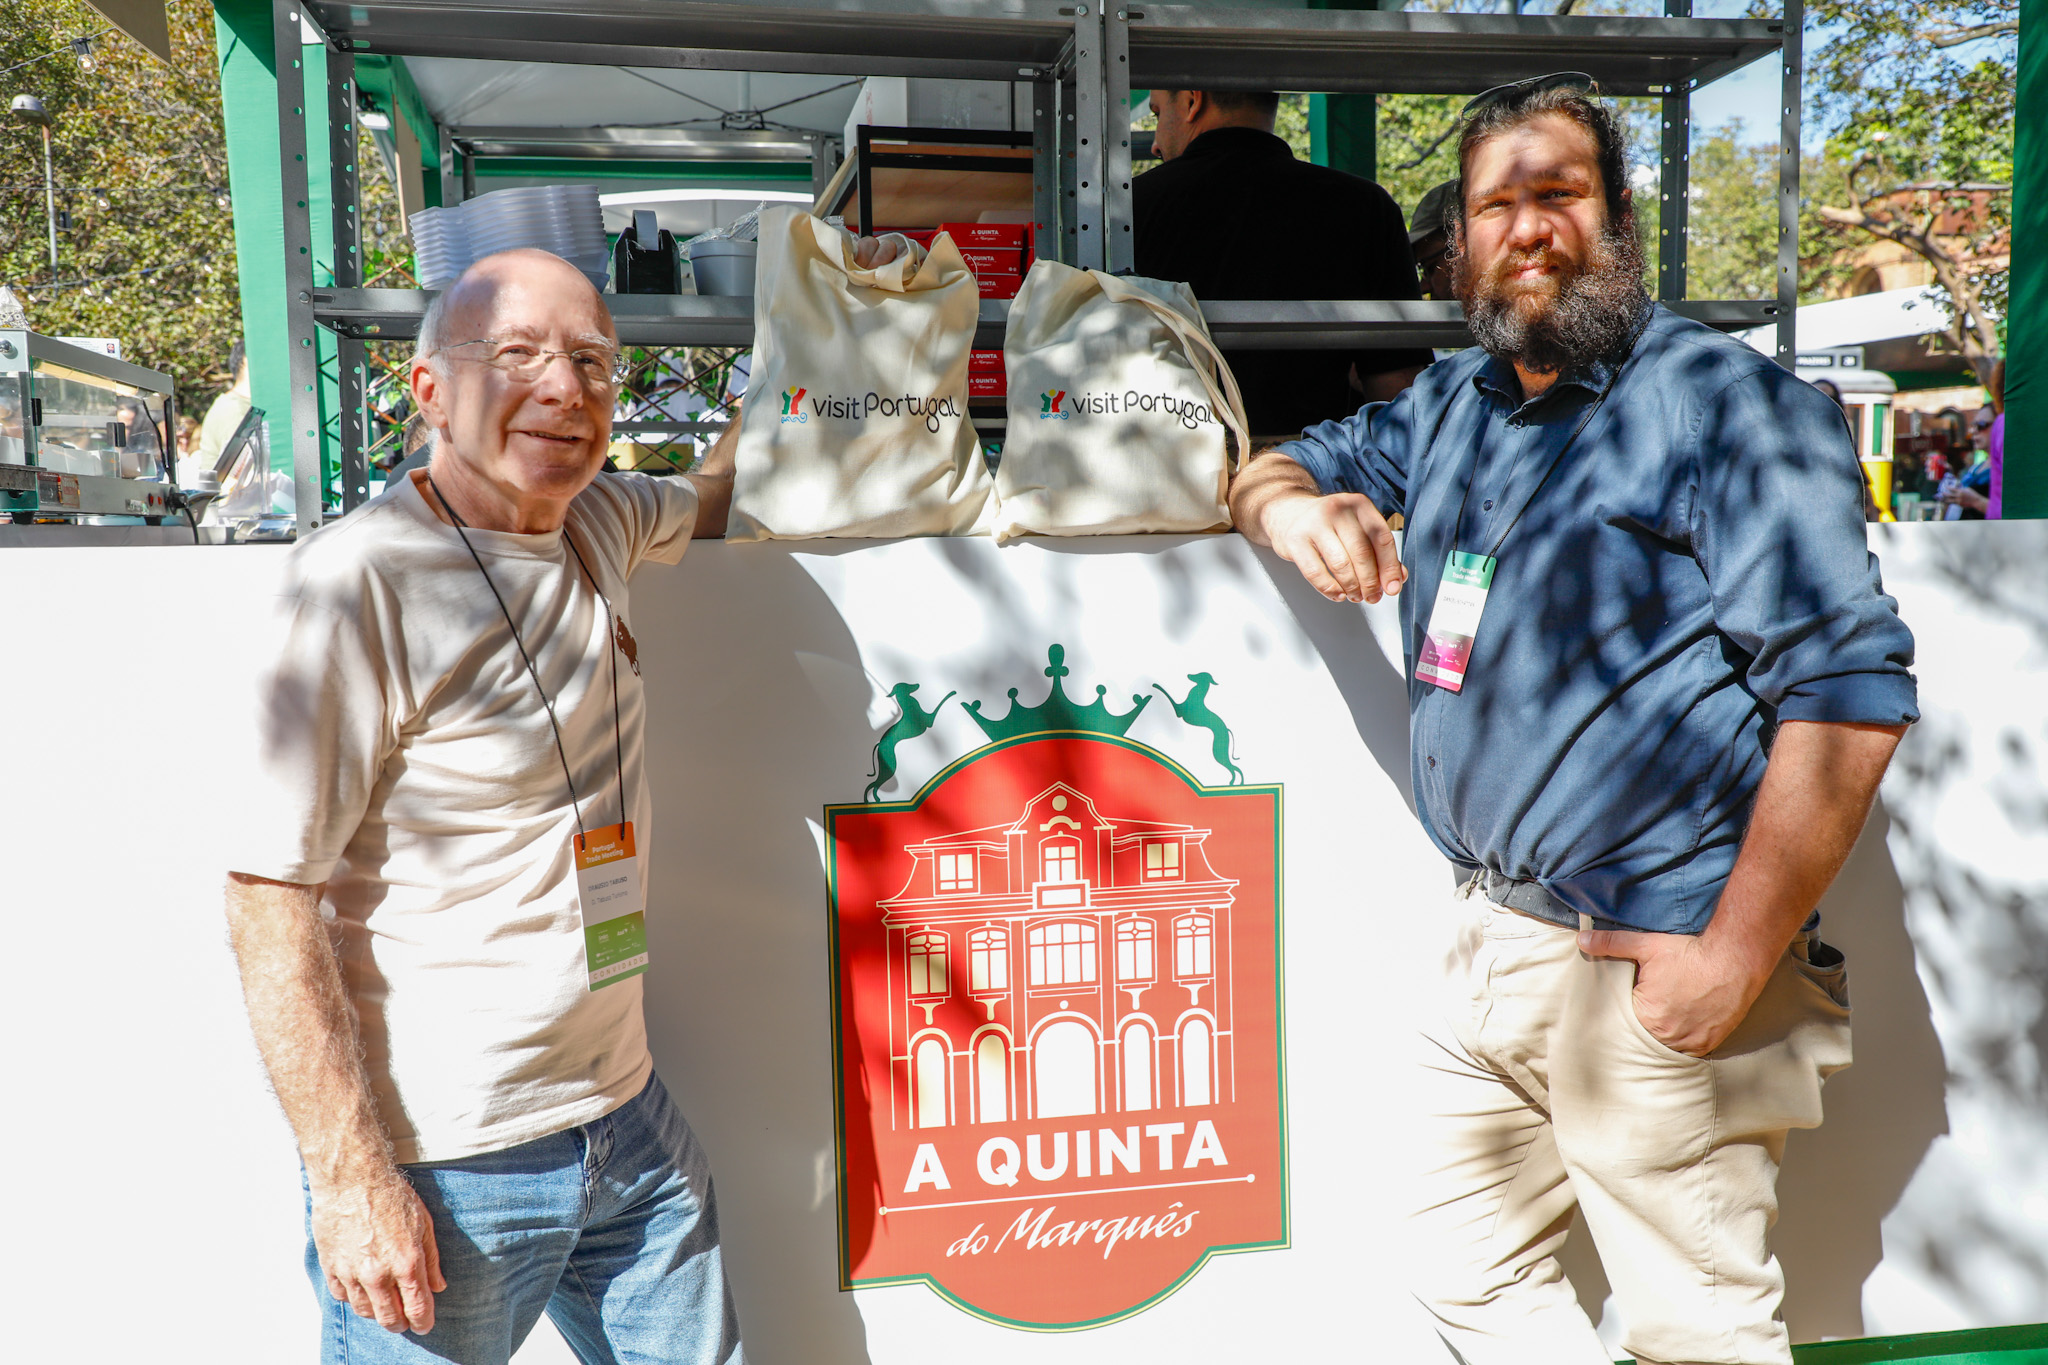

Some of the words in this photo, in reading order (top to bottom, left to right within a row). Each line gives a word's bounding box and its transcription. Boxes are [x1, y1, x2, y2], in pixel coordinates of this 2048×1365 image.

[812, 394, 860, 420] visit
[864, 391, 961, 434] Portugal
[1072, 392, 1119, 414] visit
[585, 854, 601, 864] Trade
[601, 848, 624, 860] Meeting
[592, 841, 615, 854] Portugal
[593, 956, 644, 980] CONVIDADO
[903, 1143, 951, 1193] A
[976, 1119, 1229, 1188] QUINTA
[946, 1223, 989, 1258] do
[993, 1201, 1200, 1260] Marquês
